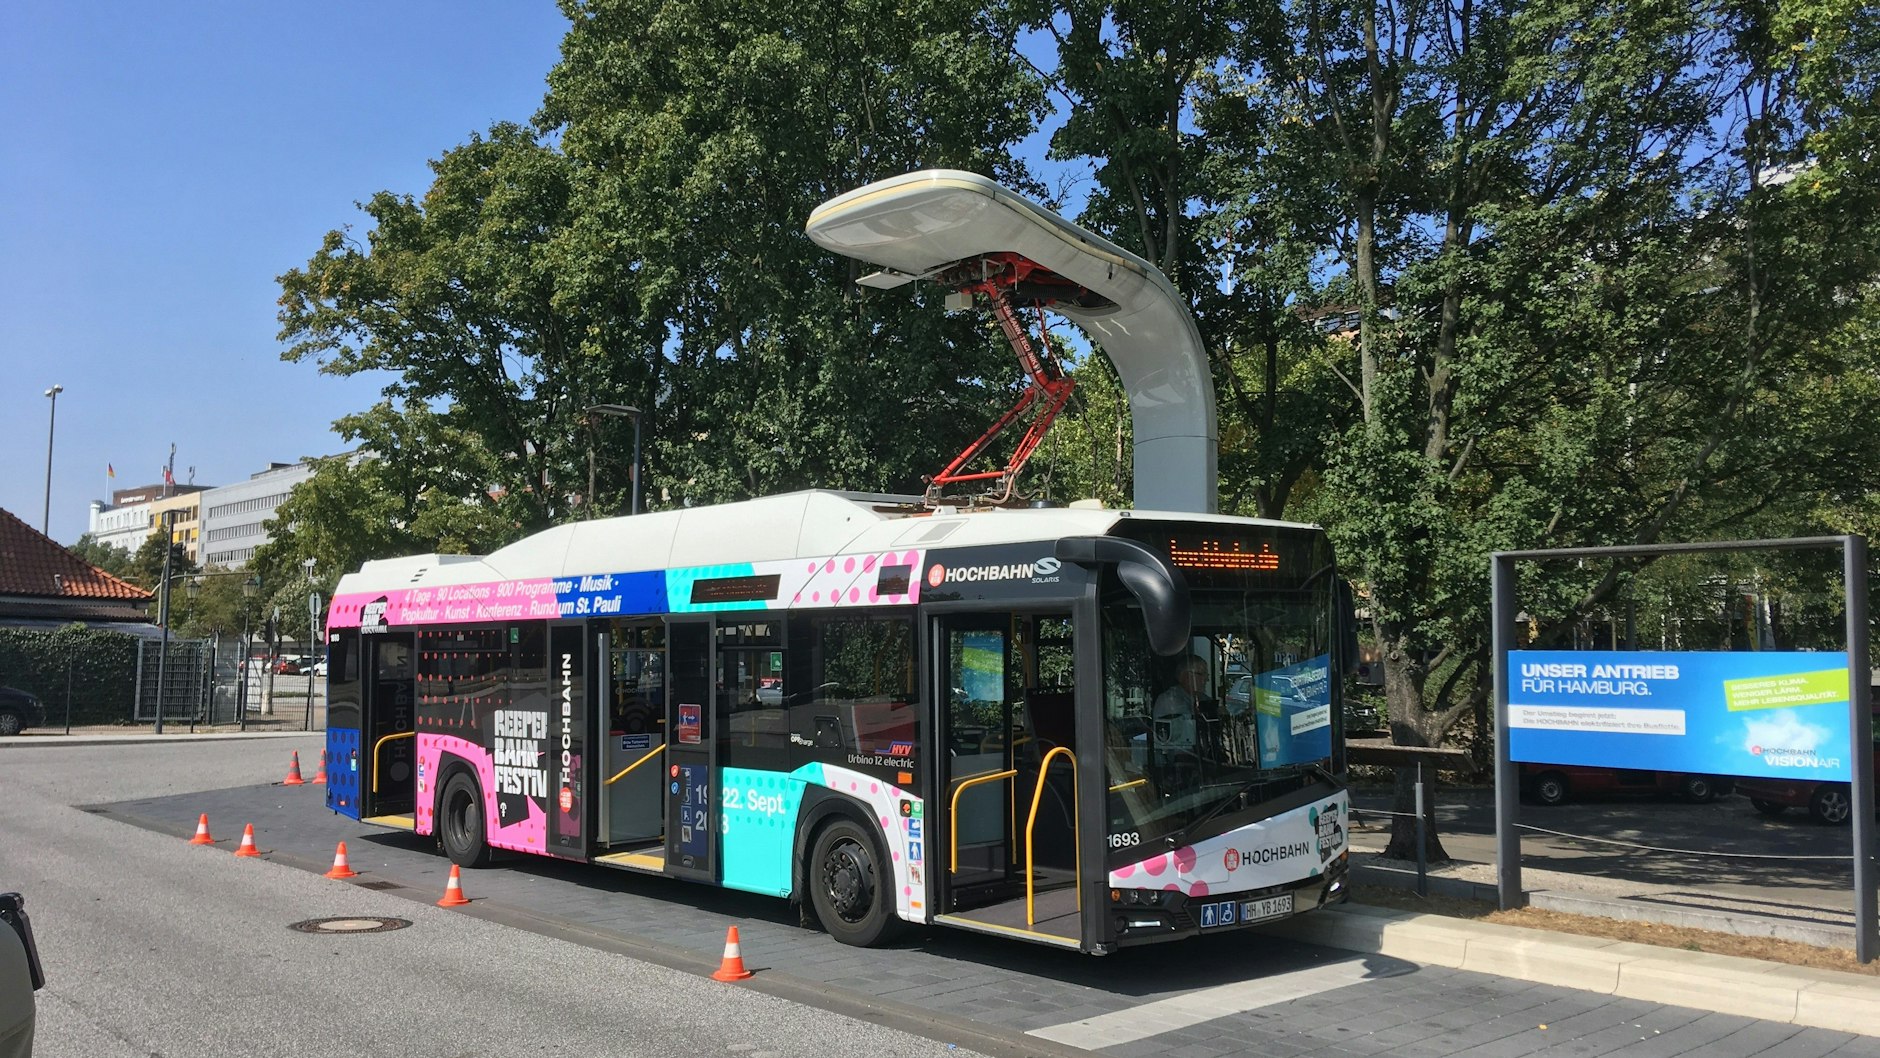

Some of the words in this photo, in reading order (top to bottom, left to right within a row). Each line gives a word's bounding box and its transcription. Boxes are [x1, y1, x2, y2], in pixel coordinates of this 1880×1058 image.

[945, 563, 1034, 582] HOCHBAHN
[1031, 576, 1060, 584] SOLARIS
[405, 591, 411, 602] 4
[413, 590, 431, 606] Tage
[436, 589, 446, 600] 90
[448, 585, 490, 600] Locations
[497, 583, 514, 597] 900
[517, 579, 573, 599] Programme
[579, 575, 612, 592] Musik
[401, 607, 439, 624] Popkultur
[444, 605, 470, 619] Kunst
[475, 602, 522, 618] Konferenz
[529, 600, 556, 616] Rund
[558, 603, 575, 615] um
[576, 599, 591, 614] St.
[593, 595, 622, 613] Pauli
[1521, 664, 1587, 678] UNSER
[1592, 664, 1679, 680] ANTRIEB
[1522, 677, 1555, 693] FÜR
[1559, 680, 1652, 695] HAMBURG.
[562, 653, 572, 783] HOCHBAHN
[494, 737, 539, 768] BAHN
[891, 744, 912, 756] HVV
[1761, 747, 1816, 756] HOCHBAHN
[847, 753, 874, 766] Urbino
[874, 755, 883, 766] 12
[883, 756, 914, 769] electric
[1107, 832, 1140, 849] 1693
[1242, 841, 1310, 866] HOCHBAHN
[1246, 904, 1257, 918] HH
[1261, 901, 1271, 915] YB
[1272, 897, 1291, 913] 1693
